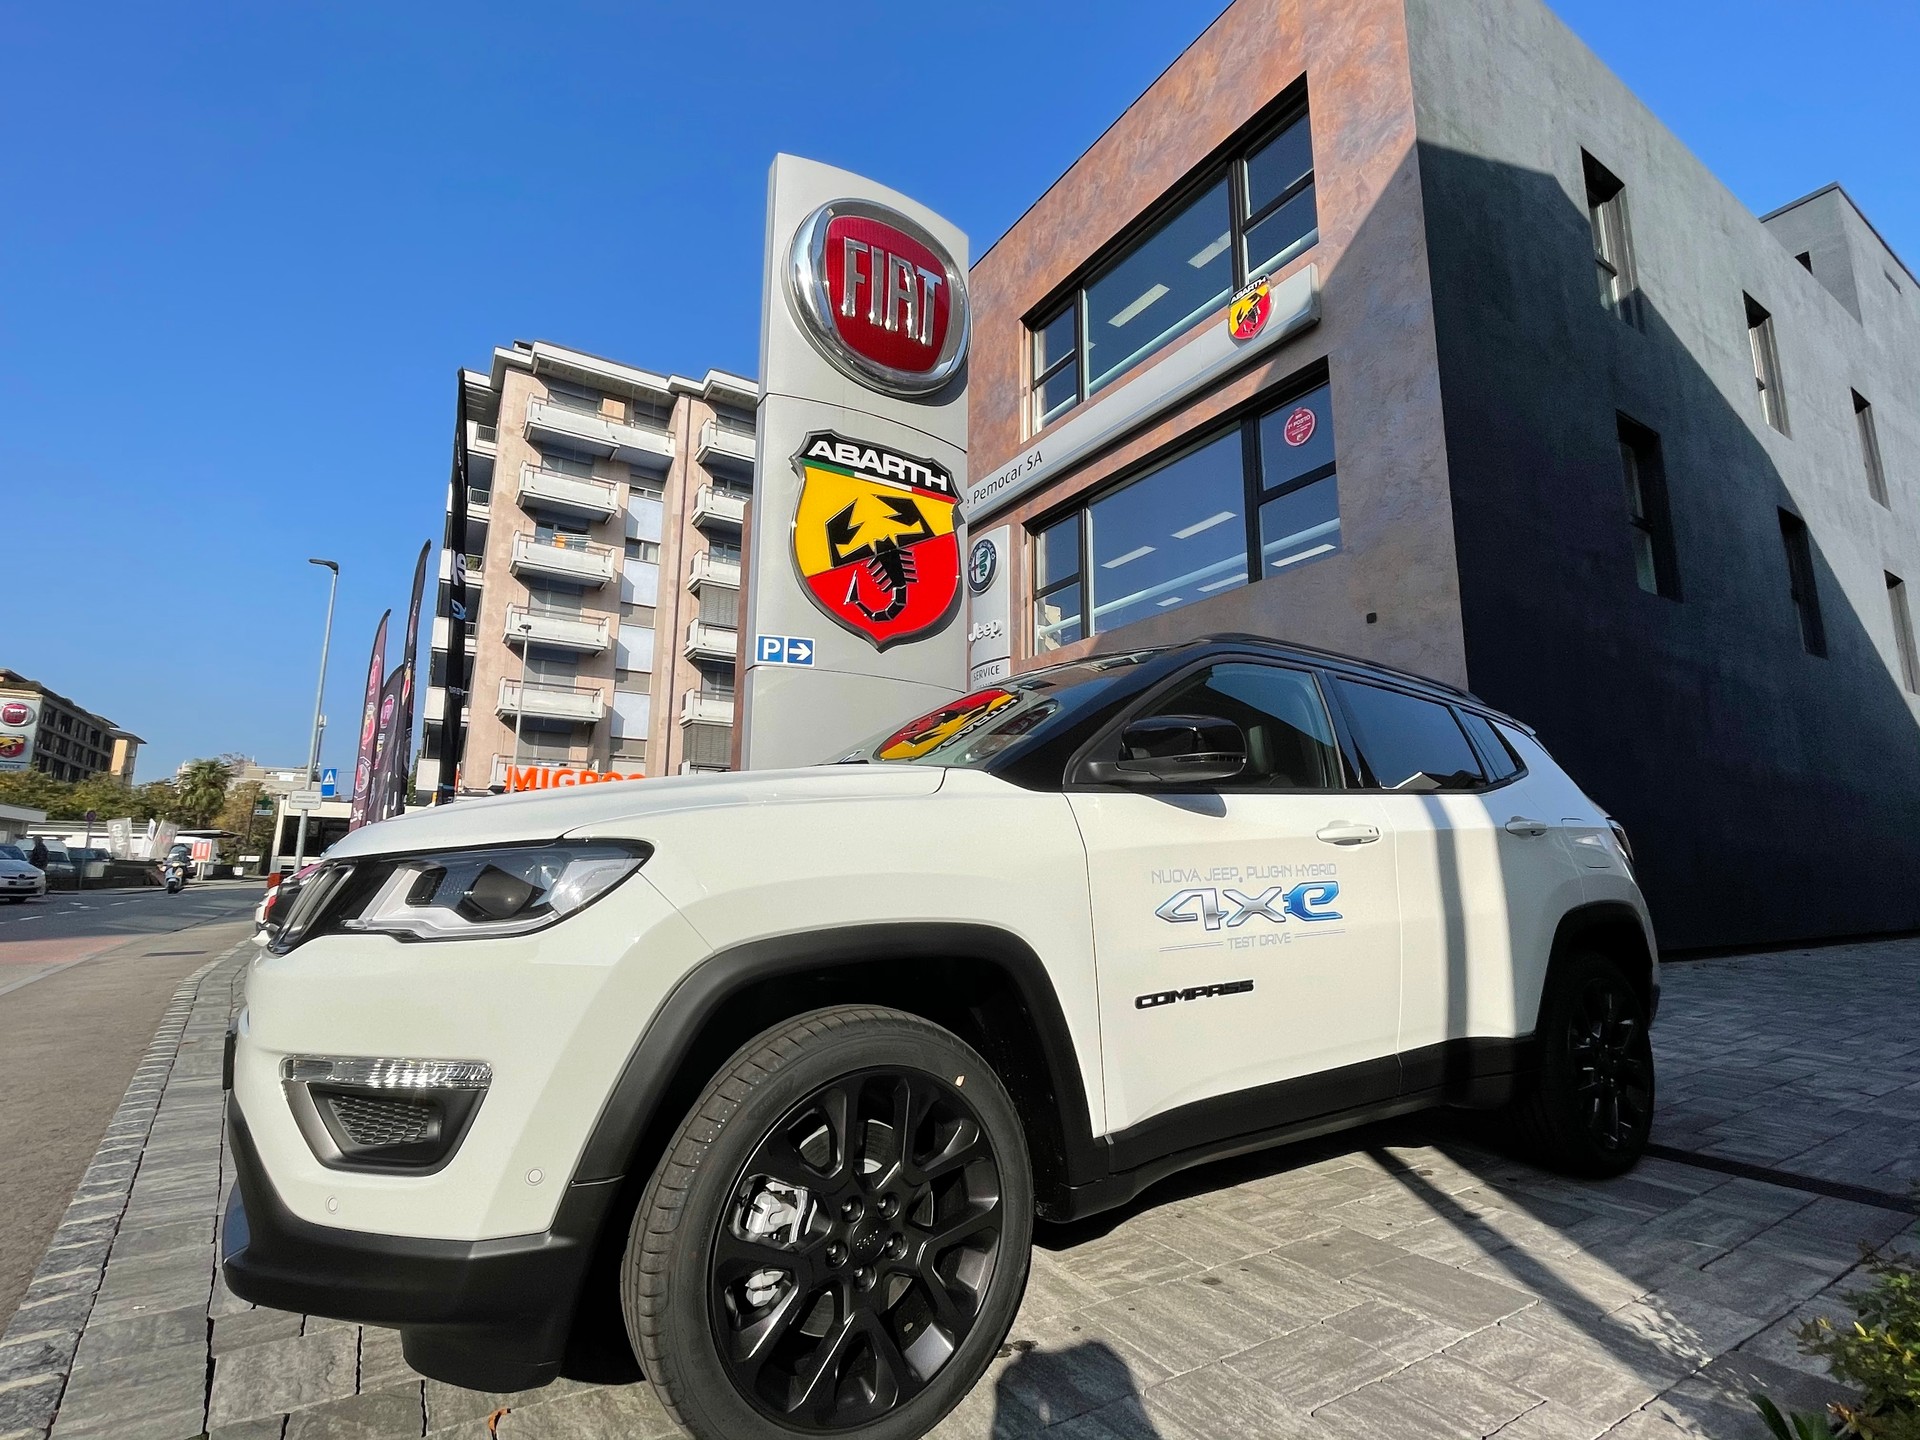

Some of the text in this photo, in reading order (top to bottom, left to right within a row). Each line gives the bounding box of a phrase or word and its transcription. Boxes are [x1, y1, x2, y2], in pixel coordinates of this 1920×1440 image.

[841, 236, 942, 346] FIAT
[1231, 276, 1266, 304] ABARTH
[807, 440, 947, 491] ABARTH
[974, 450, 1043, 504] Pemocar SA
[968, 620, 1002, 641] Jeep
[763, 638, 781, 660] P
[973, 664, 1000, 682] SERVICE
[1152, 868, 1202, 884] NUOVA
[1295, 863, 1337, 878] HYBRID
[1227, 932, 1292, 949] TEST DRIVE
[1135, 979, 1254, 1010] COMPASS
